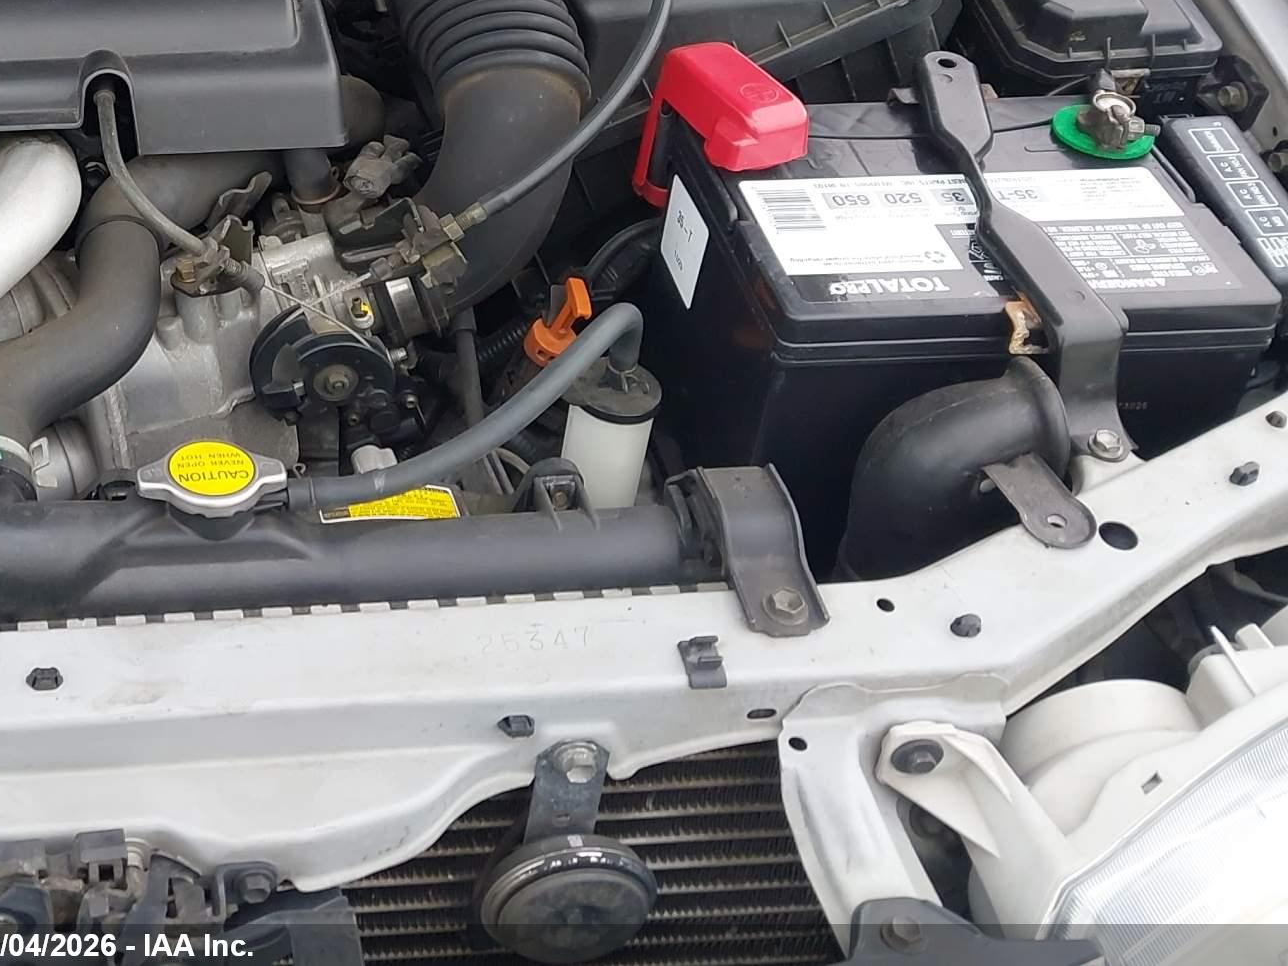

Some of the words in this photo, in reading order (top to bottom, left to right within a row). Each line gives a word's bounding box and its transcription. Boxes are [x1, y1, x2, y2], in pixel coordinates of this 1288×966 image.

[832, 194, 871, 207] 650
[883, 192, 923, 205] 520
[940, 192, 965, 203] 35
[998, 188, 1039, 201] 35-T
[828, 276, 951, 296] TOTALPRO
[177, 470, 249, 483] CAUTION
